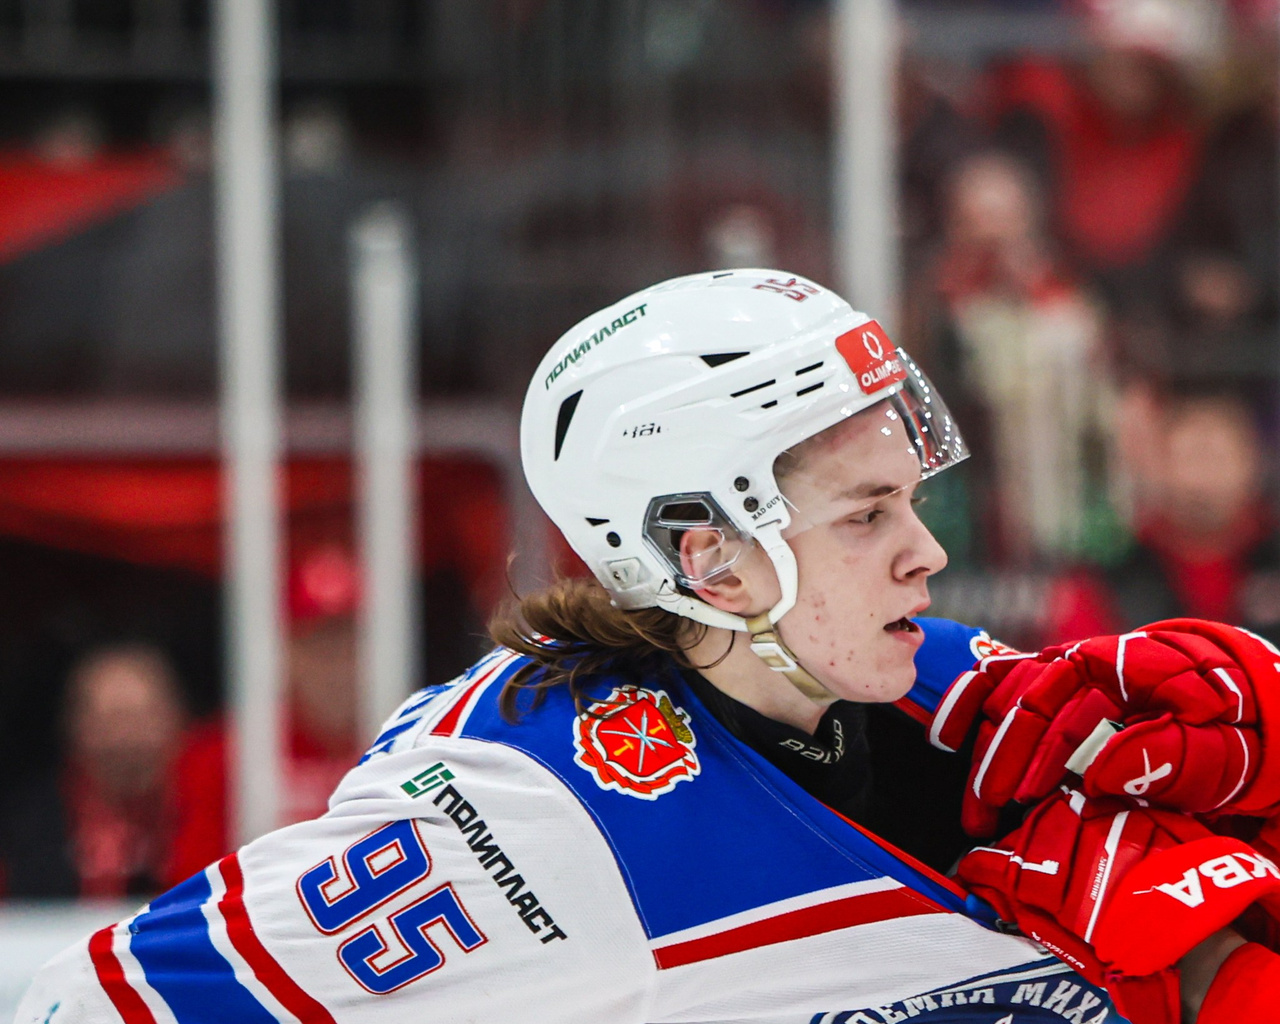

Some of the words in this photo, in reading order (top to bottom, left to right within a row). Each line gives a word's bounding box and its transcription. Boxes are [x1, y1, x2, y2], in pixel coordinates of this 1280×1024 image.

[545, 303, 648, 390] ПОЛИПЛАСТ
[751, 507, 767, 521] MAD
[766, 495, 781, 510] GUY
[296, 818, 490, 995] 95
[432, 784, 568, 944] ПОЛИПЛАСТ
